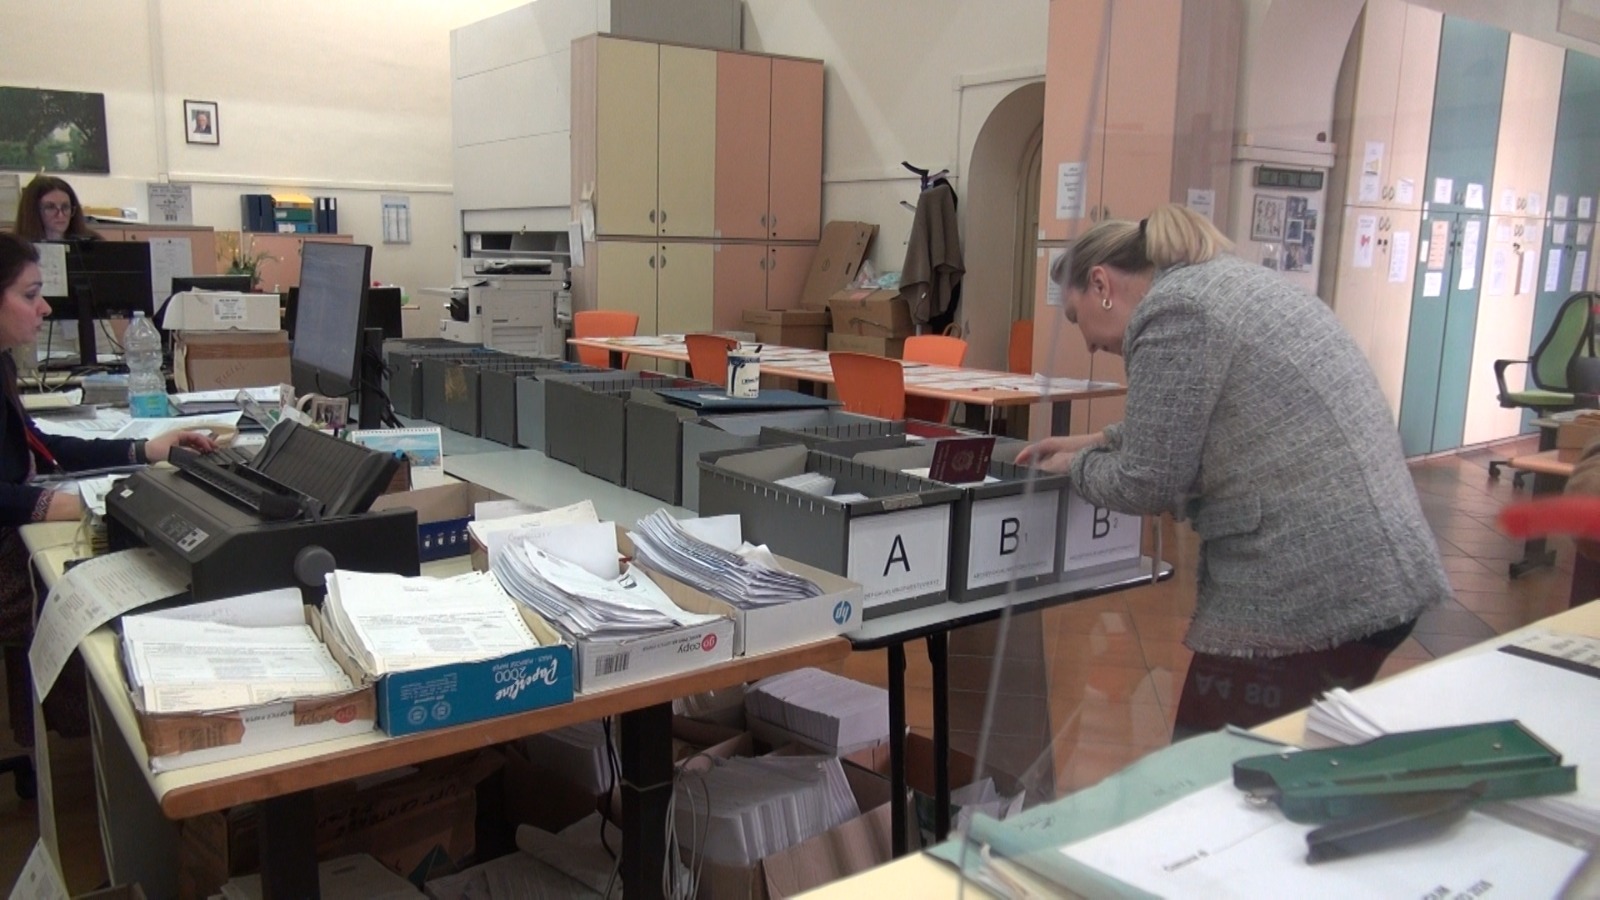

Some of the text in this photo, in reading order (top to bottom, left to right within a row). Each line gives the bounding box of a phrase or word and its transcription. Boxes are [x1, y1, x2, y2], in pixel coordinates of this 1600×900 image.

[882, 534, 911, 577] A
[834, 601, 851, 625] hp
[677, 642, 701, 653] copy
[703, 634, 716, 650] go
[495, 666, 526, 683] 2000
[495, 657, 558, 701] Paperline
